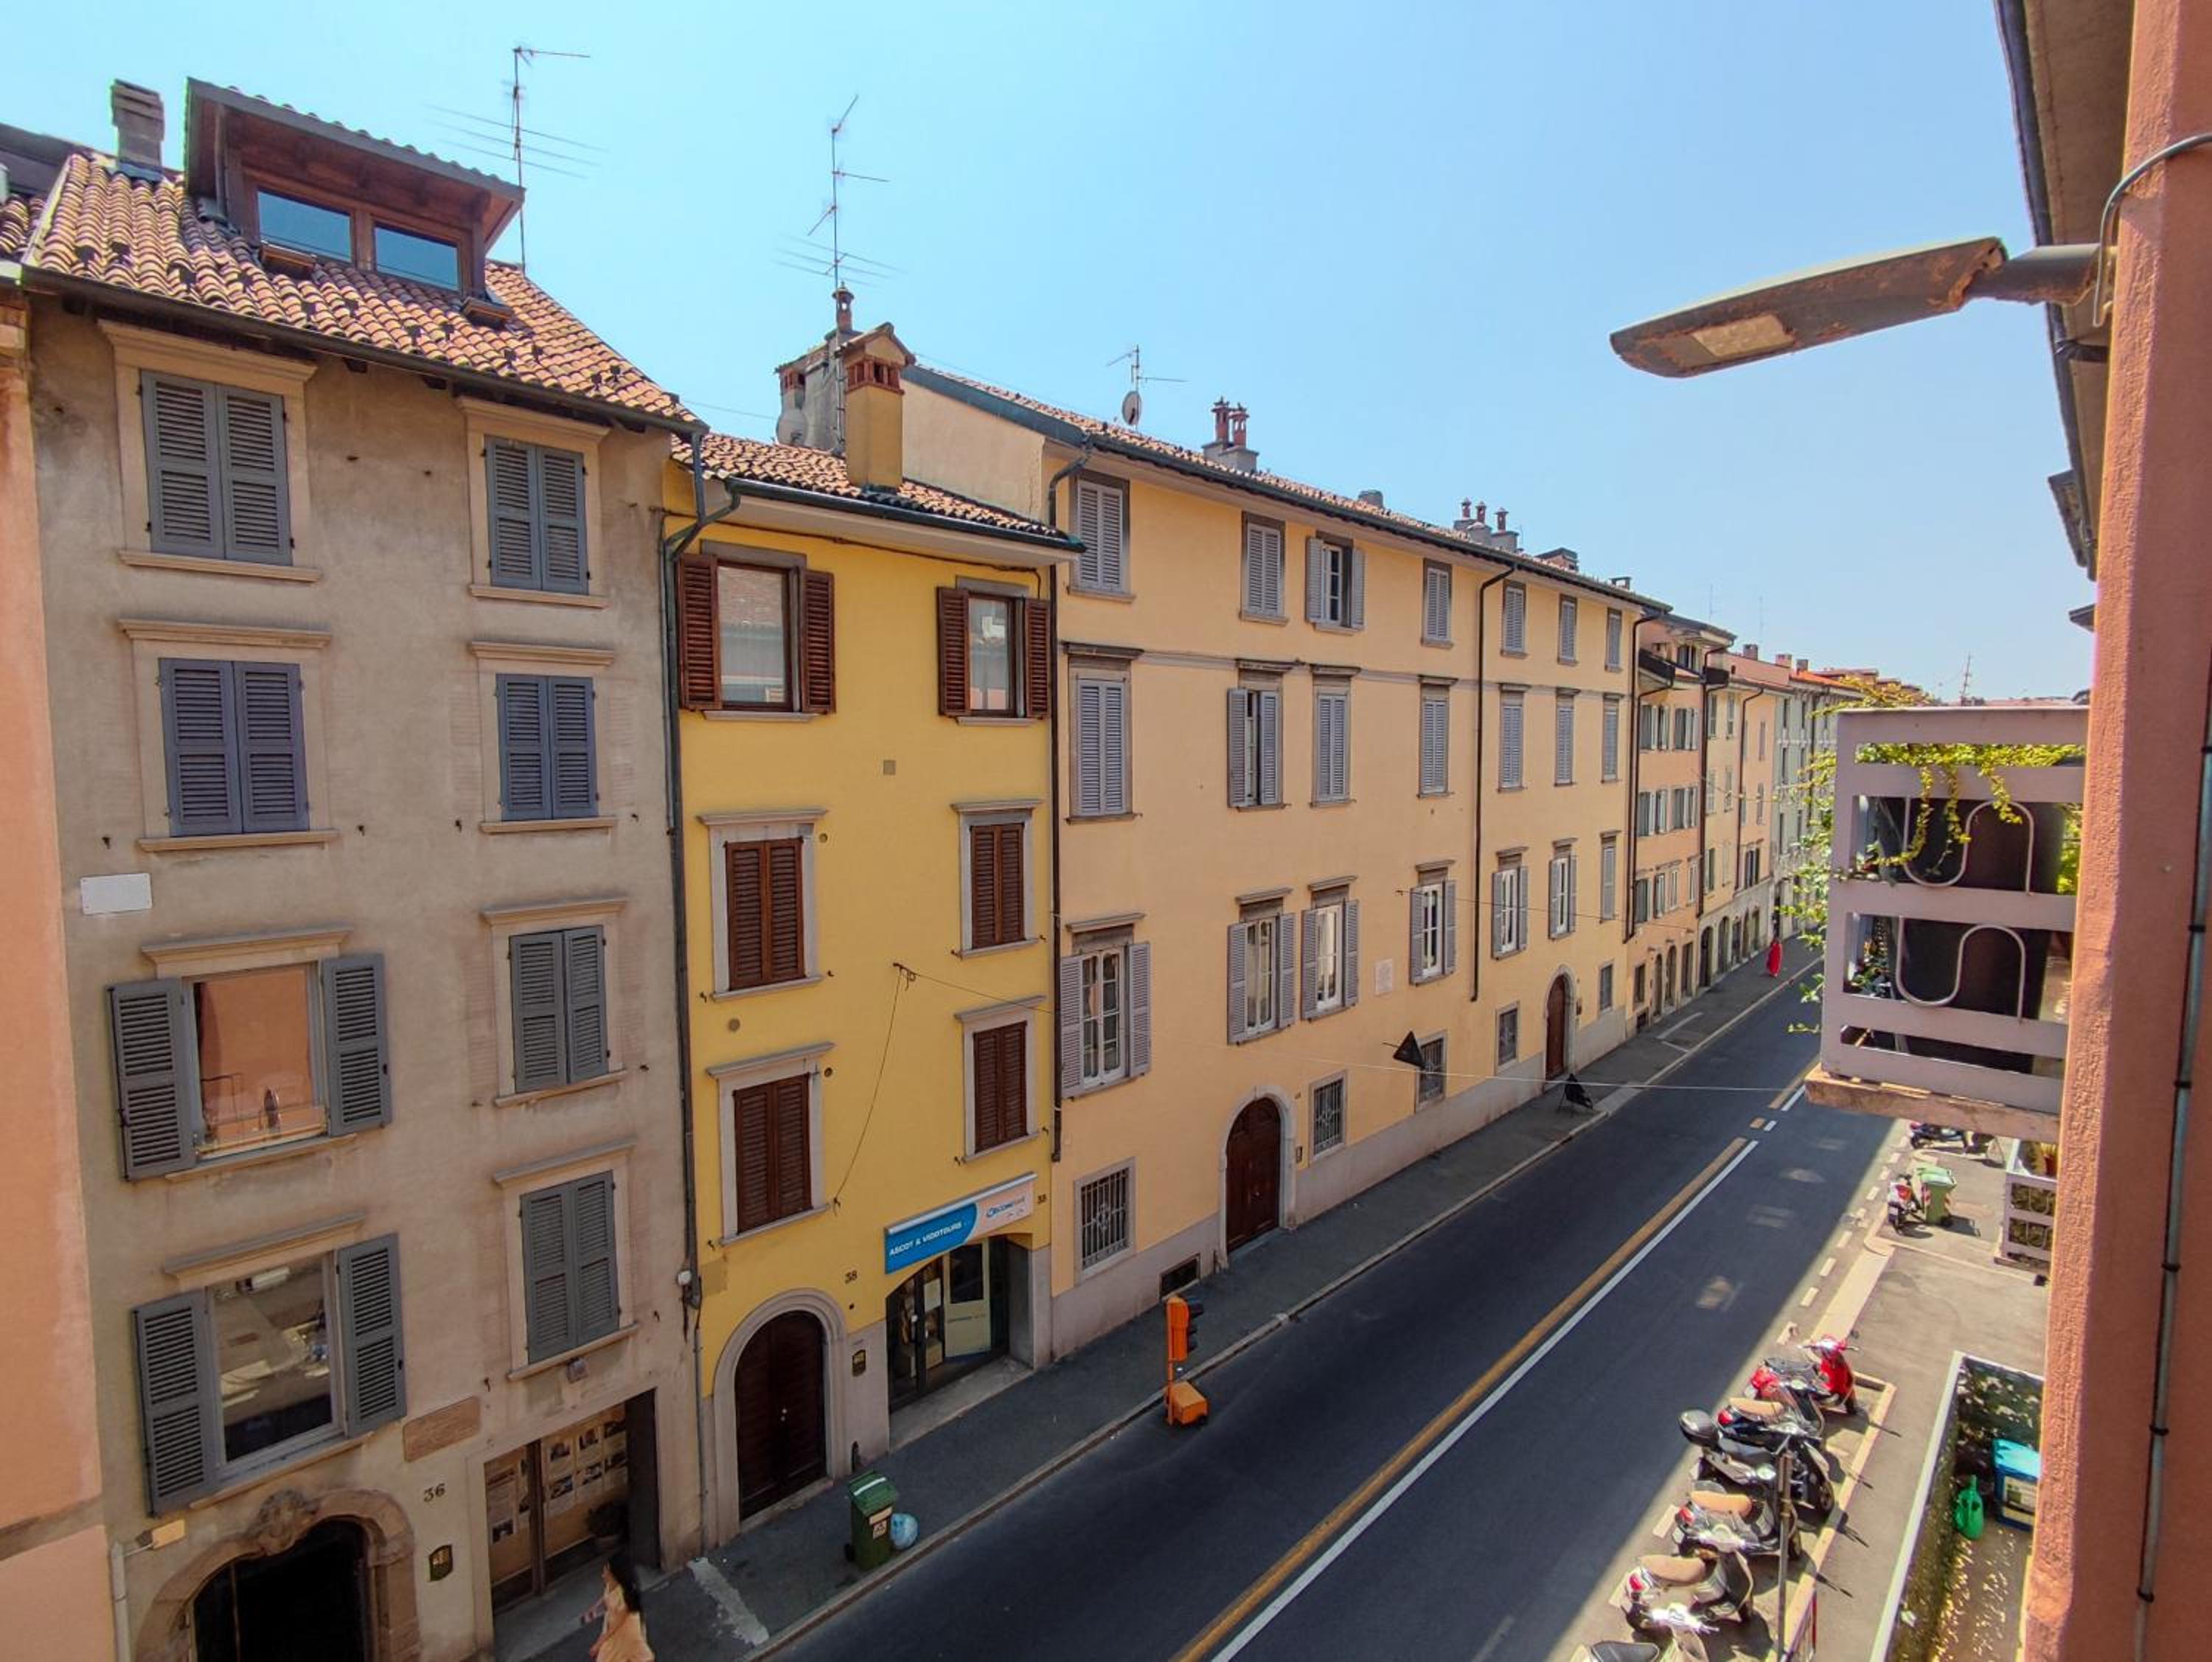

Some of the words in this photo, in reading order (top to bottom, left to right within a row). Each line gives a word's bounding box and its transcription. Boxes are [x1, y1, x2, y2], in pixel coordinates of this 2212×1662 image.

[889, 1240, 914, 1256] ASCOT
[915, 1238, 922, 1246] &
[845, 1270, 858, 1284] 38
[424, 1483, 445, 1502] 36
